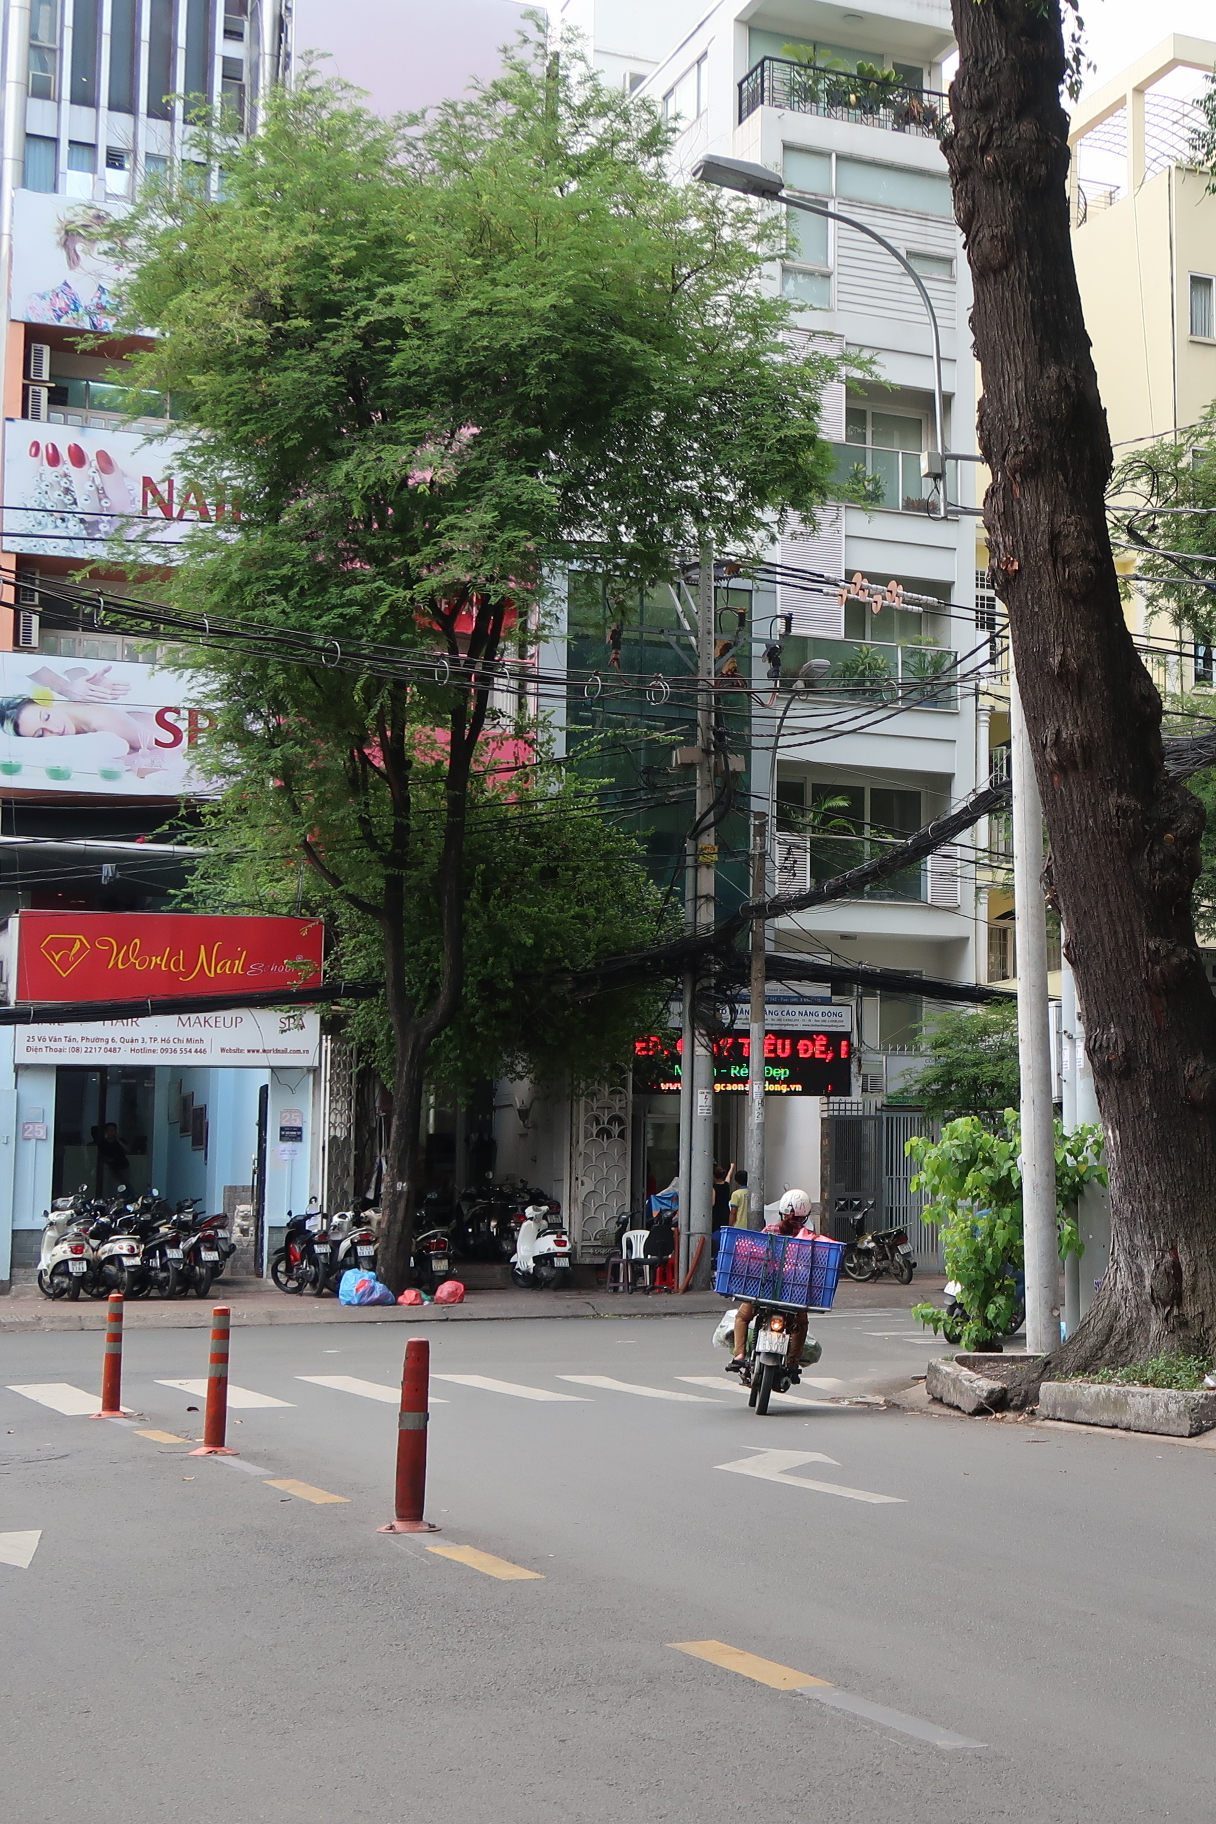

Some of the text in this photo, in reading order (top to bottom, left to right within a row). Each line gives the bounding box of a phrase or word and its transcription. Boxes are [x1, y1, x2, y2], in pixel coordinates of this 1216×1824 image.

[154, 707, 245, 751] SP
[95, 937, 295, 981] World Nail Schoo
[781, 1009, 797, 1017] CÁO
[177, 1016, 243, 1028] MAKEUP
[279, 1016, 306, 1030] SPA
[81, 1036, 109, 1045] Phường
[68, 1046, 83, 1055] (08)
[84, 1046, 102, 1054] 2217
[130, 1047, 159, 1055] Hotline:
[160, 1047, 178, 1055] 0936
[281, 1112, 300, 1126] 25
[24, 1125, 43, 1138] 25
